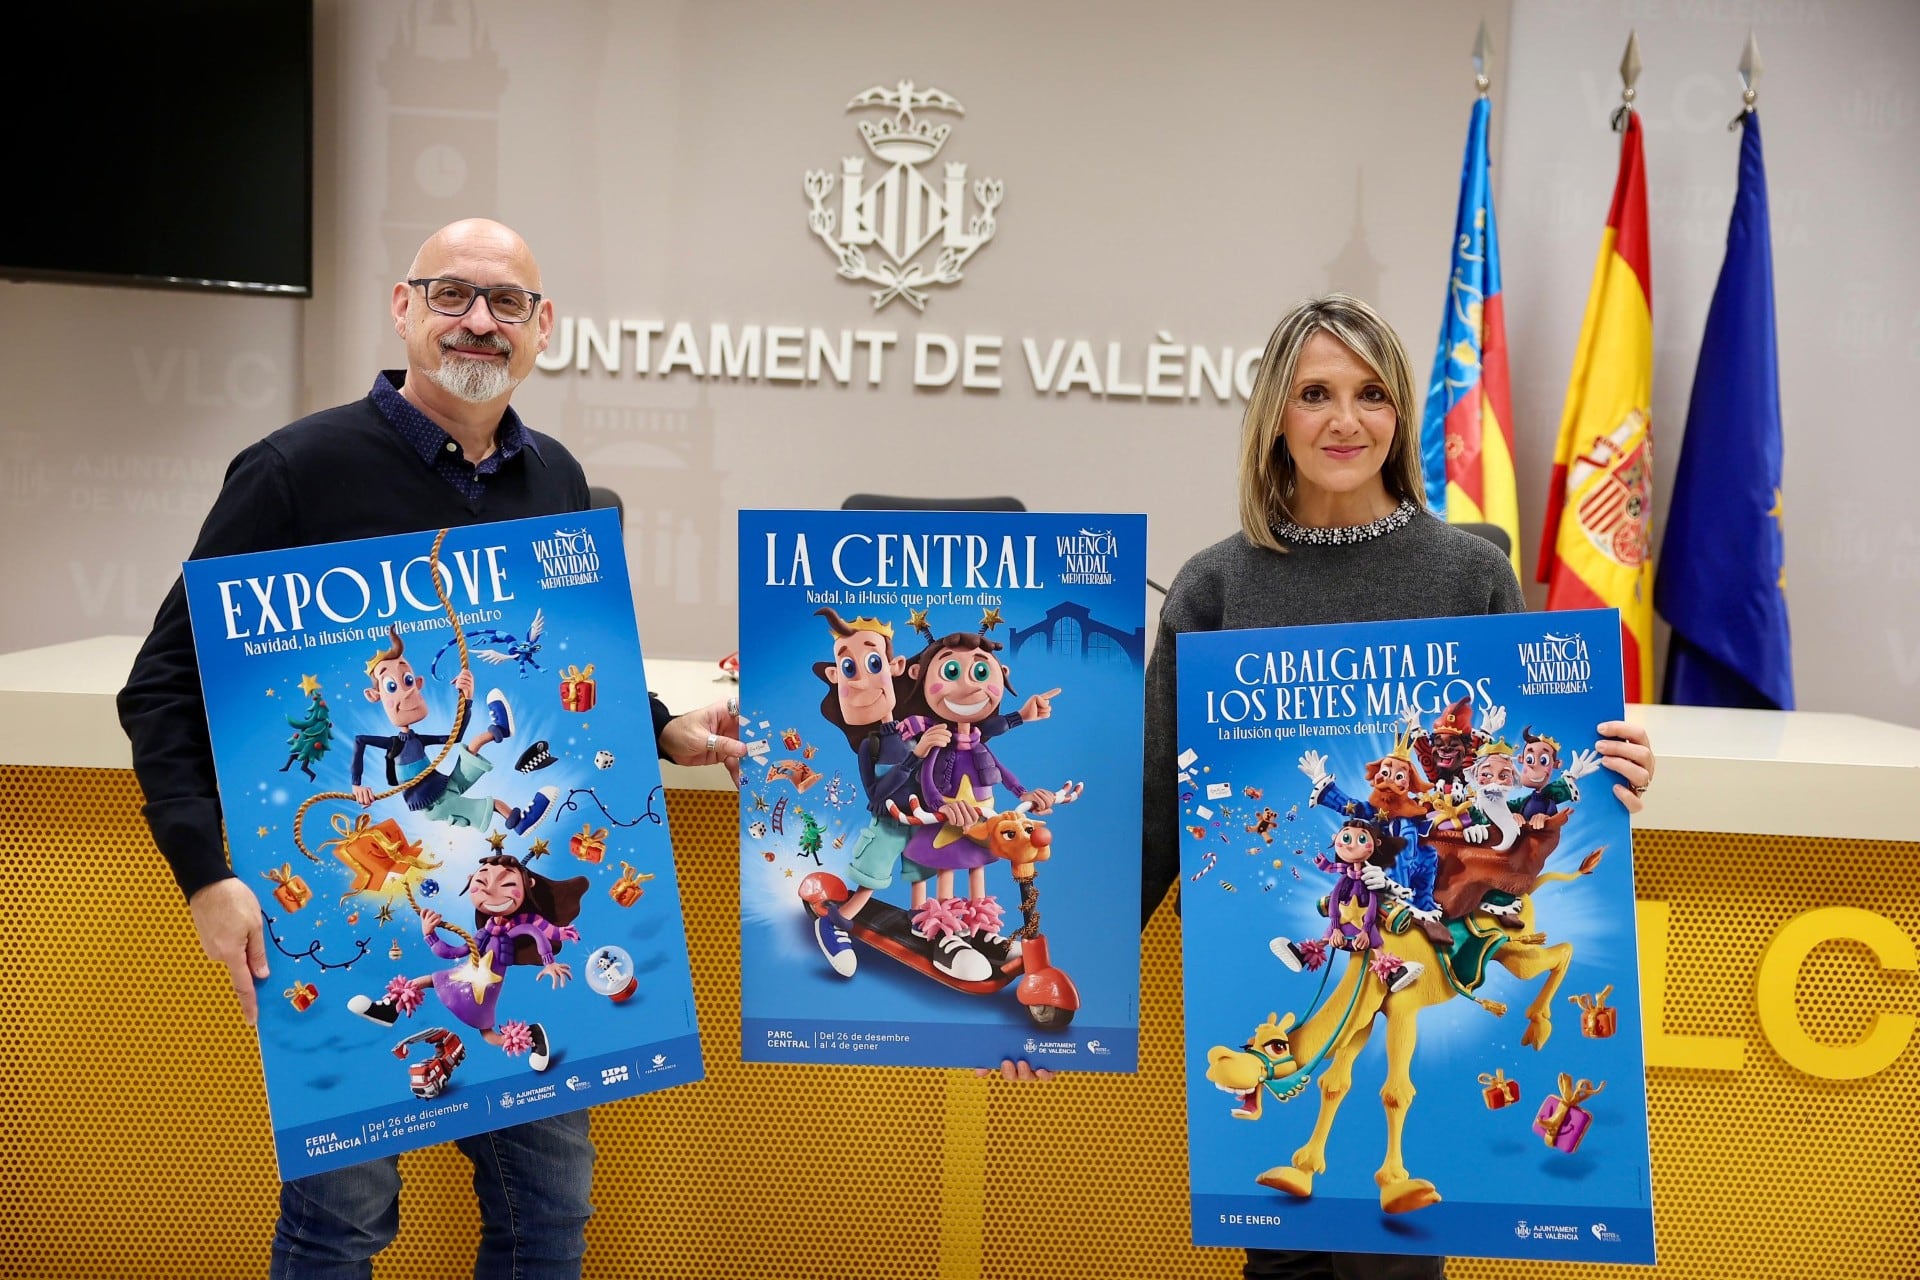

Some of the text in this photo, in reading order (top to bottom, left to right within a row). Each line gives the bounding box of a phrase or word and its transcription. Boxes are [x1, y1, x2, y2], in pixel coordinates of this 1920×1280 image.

[532, 317, 1265, 401] UNTAMENT DE VALÈNC
[542, 553, 600, 578] NAVIDAD
[765, 532, 1044, 589] LA CENTRAL
[1066, 554, 1109, 574] NADAL
[217, 546, 515, 640] EXPOJOVE
[806, 590, 843, 606] Nadal,
[845, 590, 856, 604] la
[901, 593, 923, 607] que
[926, 592, 973, 608] portem
[977, 592, 1002, 606] dins
[244, 609, 502, 657] Navidad, la ilusión que llevamos dentro
[1235, 642, 1460, 686] CABALGATA DE
[1527, 661, 1591, 682] NAVIDAD
[1206, 677, 1493, 724] LOS REYES MAGOS
[1233, 726, 1272, 740] ilusión
[1274, 727, 1296, 741] que
[1299, 724, 1350, 737] llevamos
[1353, 721, 1397, 734] dentro
[1633, 900, 1919, 1080] LC
[767, 1031, 793, 1039] PARC
[767, 1040, 810, 1049] CENTRAL
[819, 1032, 910, 1042] Del 26 de desembre
[819, 1041, 879, 1052] al 4 de gener
[601, 1065, 628, 1078] EXPO
[602, 1072, 629, 1086] JOVE
[516, 1085, 555, 1099] AJUNTAMENT
[368, 1102, 469, 1133] Del 26 de diciembre
[305, 1132, 338, 1147] FERIA
[370, 1120, 436, 1143] al 4 de enero
[307, 1137, 362, 1158] VALENCIA
[1220, 1214, 1281, 1226] 5 DE ENERO
[1533, 1225, 1578, 1233] AJUNTAMENT
